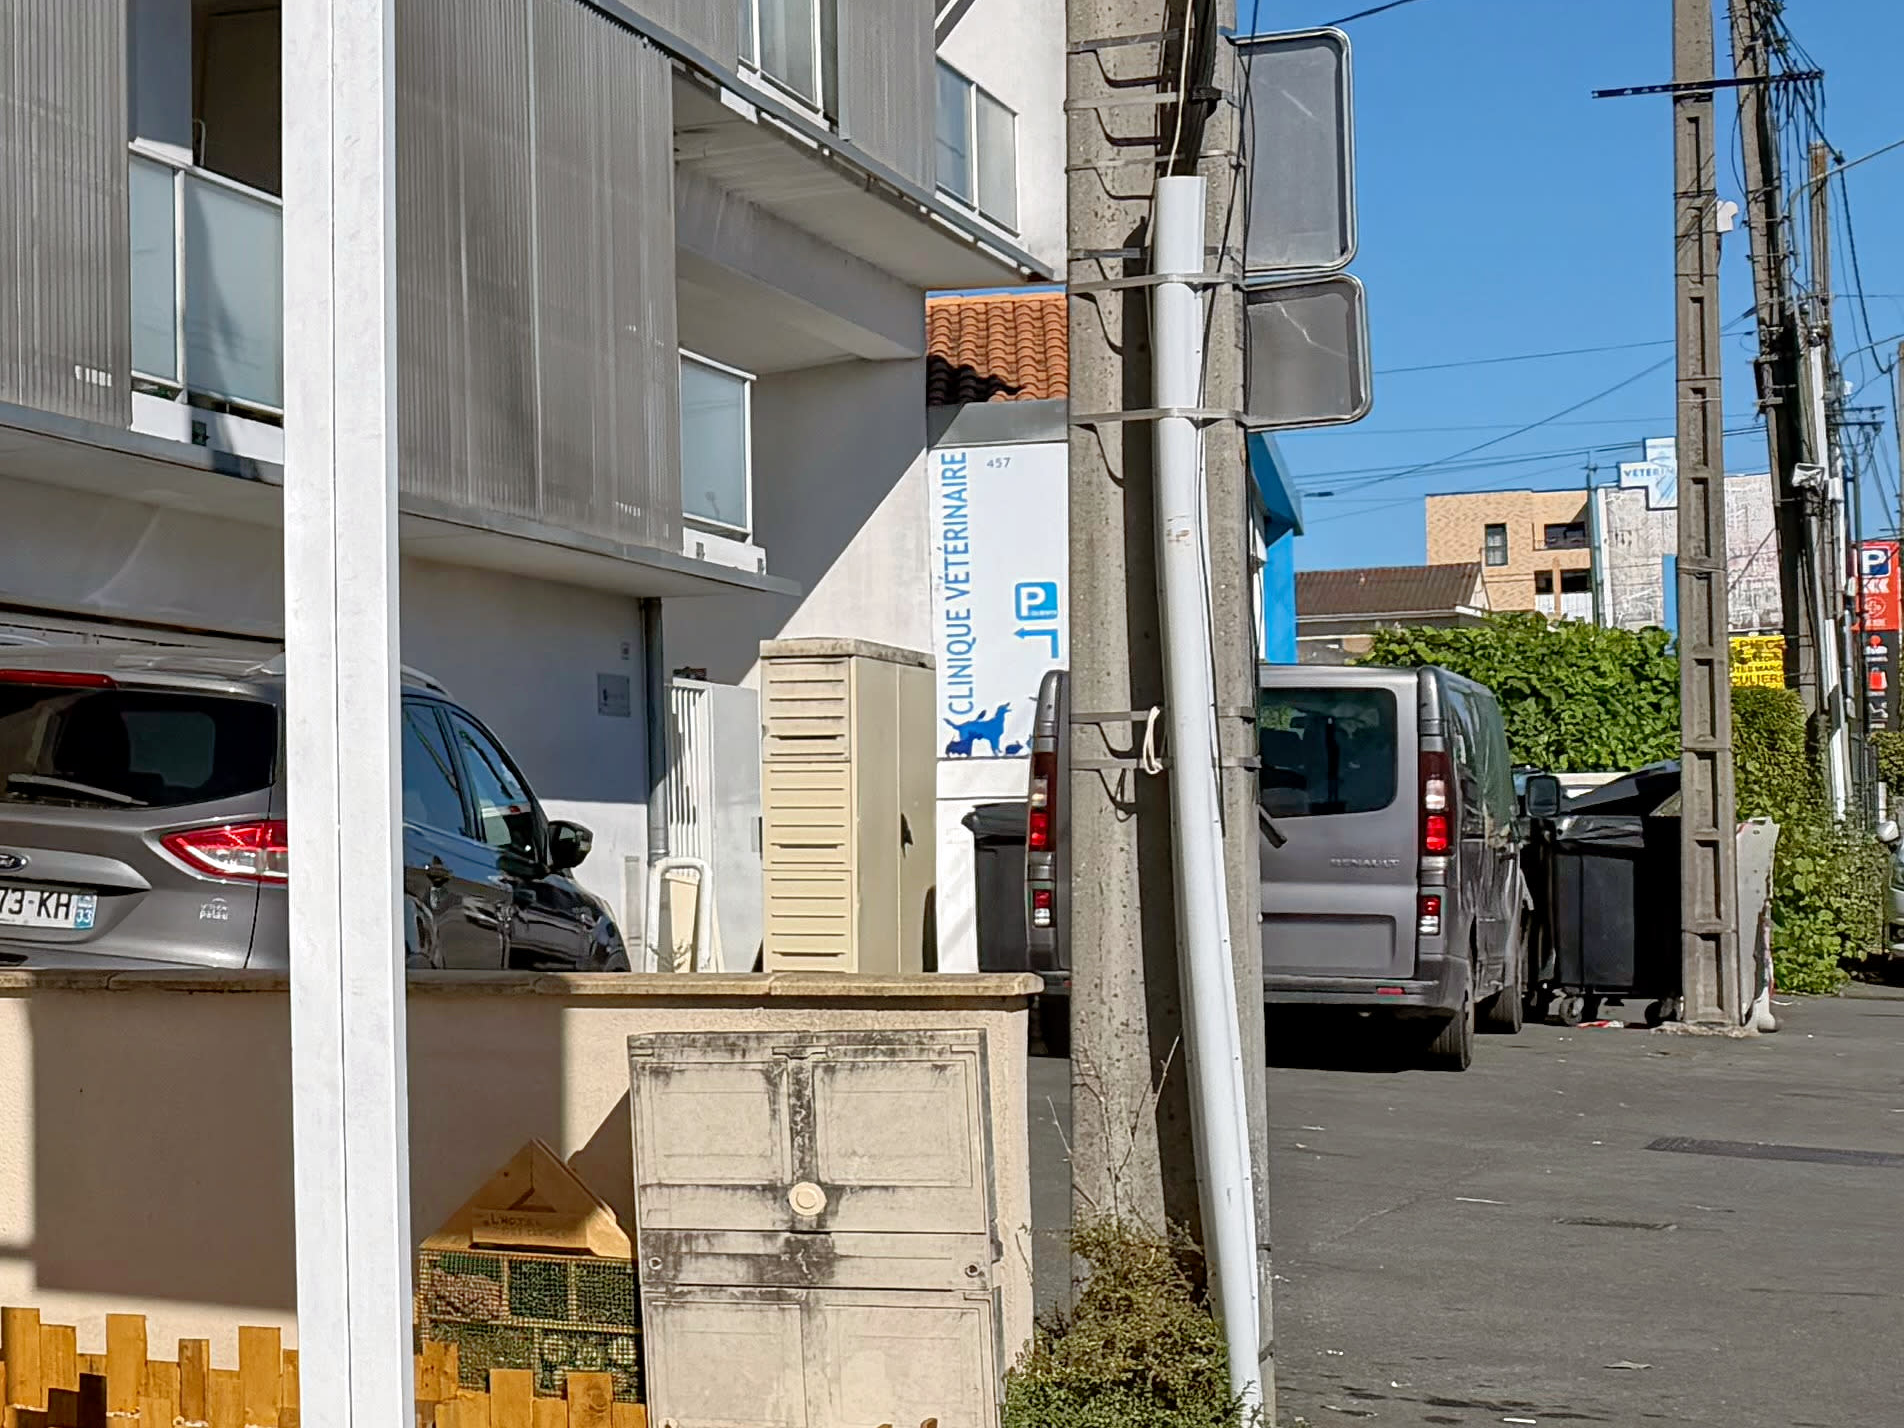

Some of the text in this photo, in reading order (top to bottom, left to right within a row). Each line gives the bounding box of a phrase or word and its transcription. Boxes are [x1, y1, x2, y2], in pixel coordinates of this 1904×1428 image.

[986, 457, 1010, 469] 457
[1862, 550, 1886, 574] P
[937, 451, 976, 714] CLINIQUE VÉTÉRINAIRE
[1020, 587, 1045, 616] P
[1330, 858, 1400, 868] RENAULT
[76, 910, 92, 922] 33
